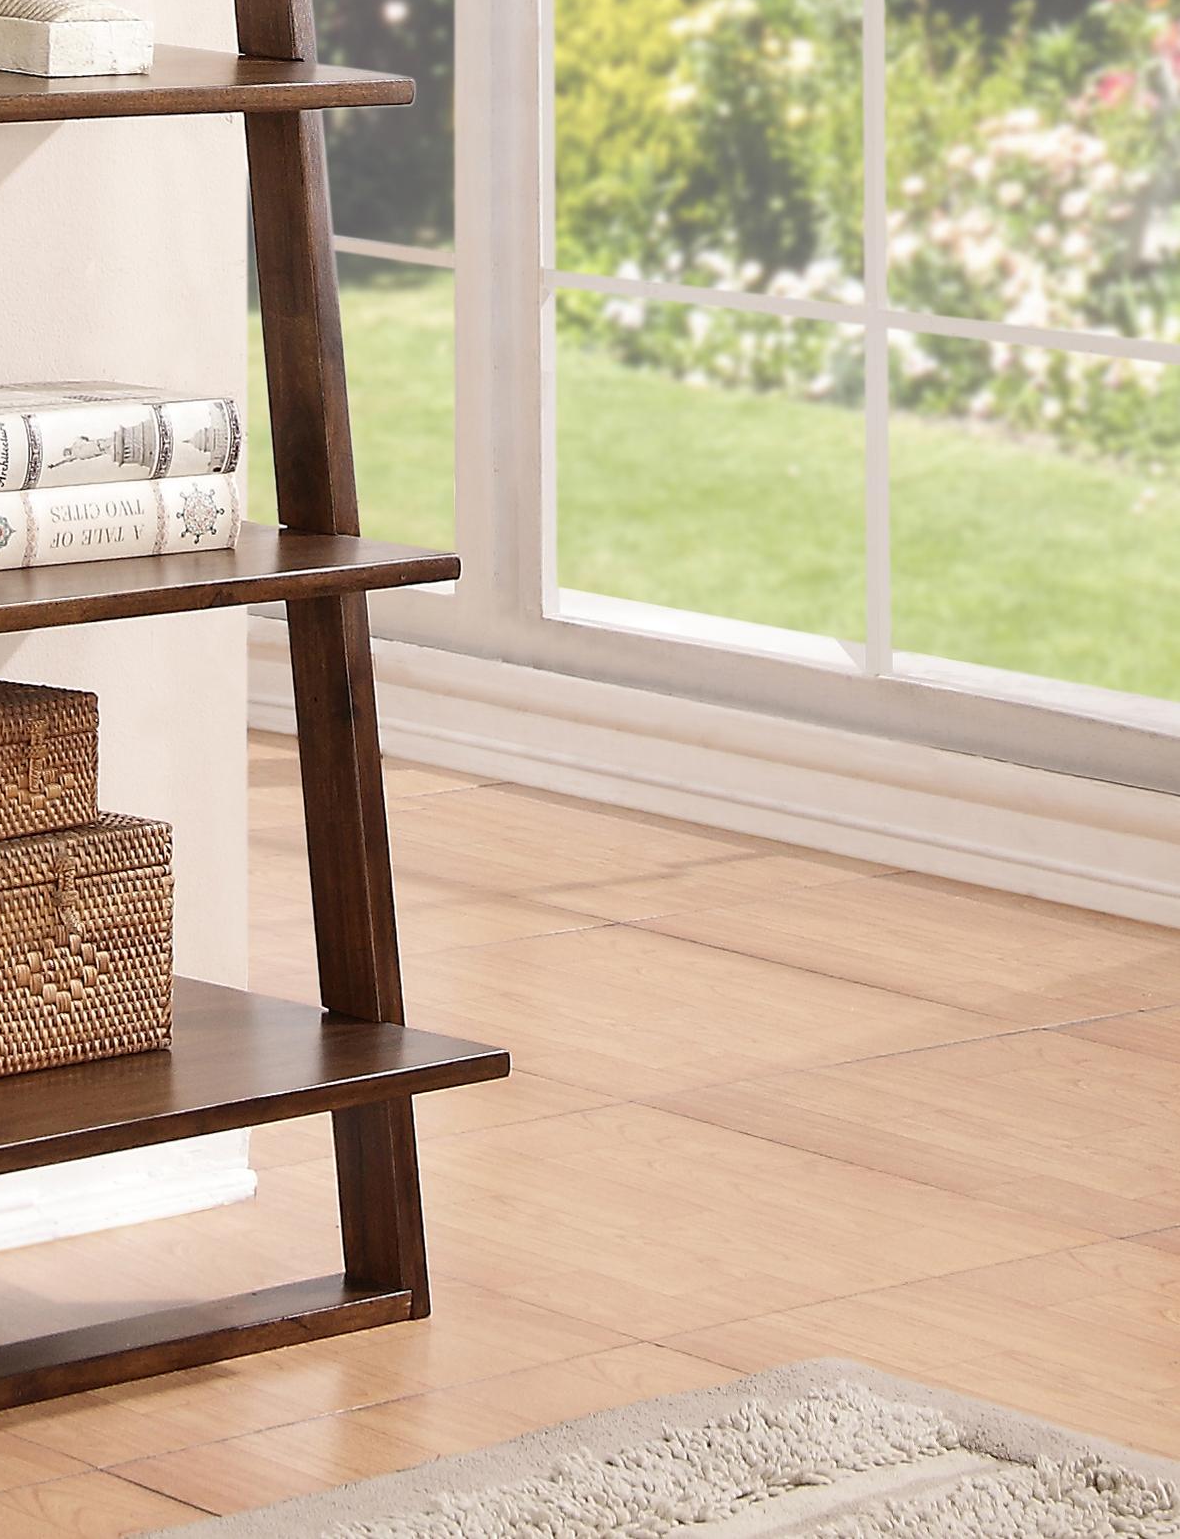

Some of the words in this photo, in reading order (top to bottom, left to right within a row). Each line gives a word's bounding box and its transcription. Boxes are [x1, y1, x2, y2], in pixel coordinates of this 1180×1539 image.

[105, 499, 145, 519] TWO
[49, 531, 74, 549] OF
[81, 526, 125, 547] TALE
[133, 524, 145, 541] A
